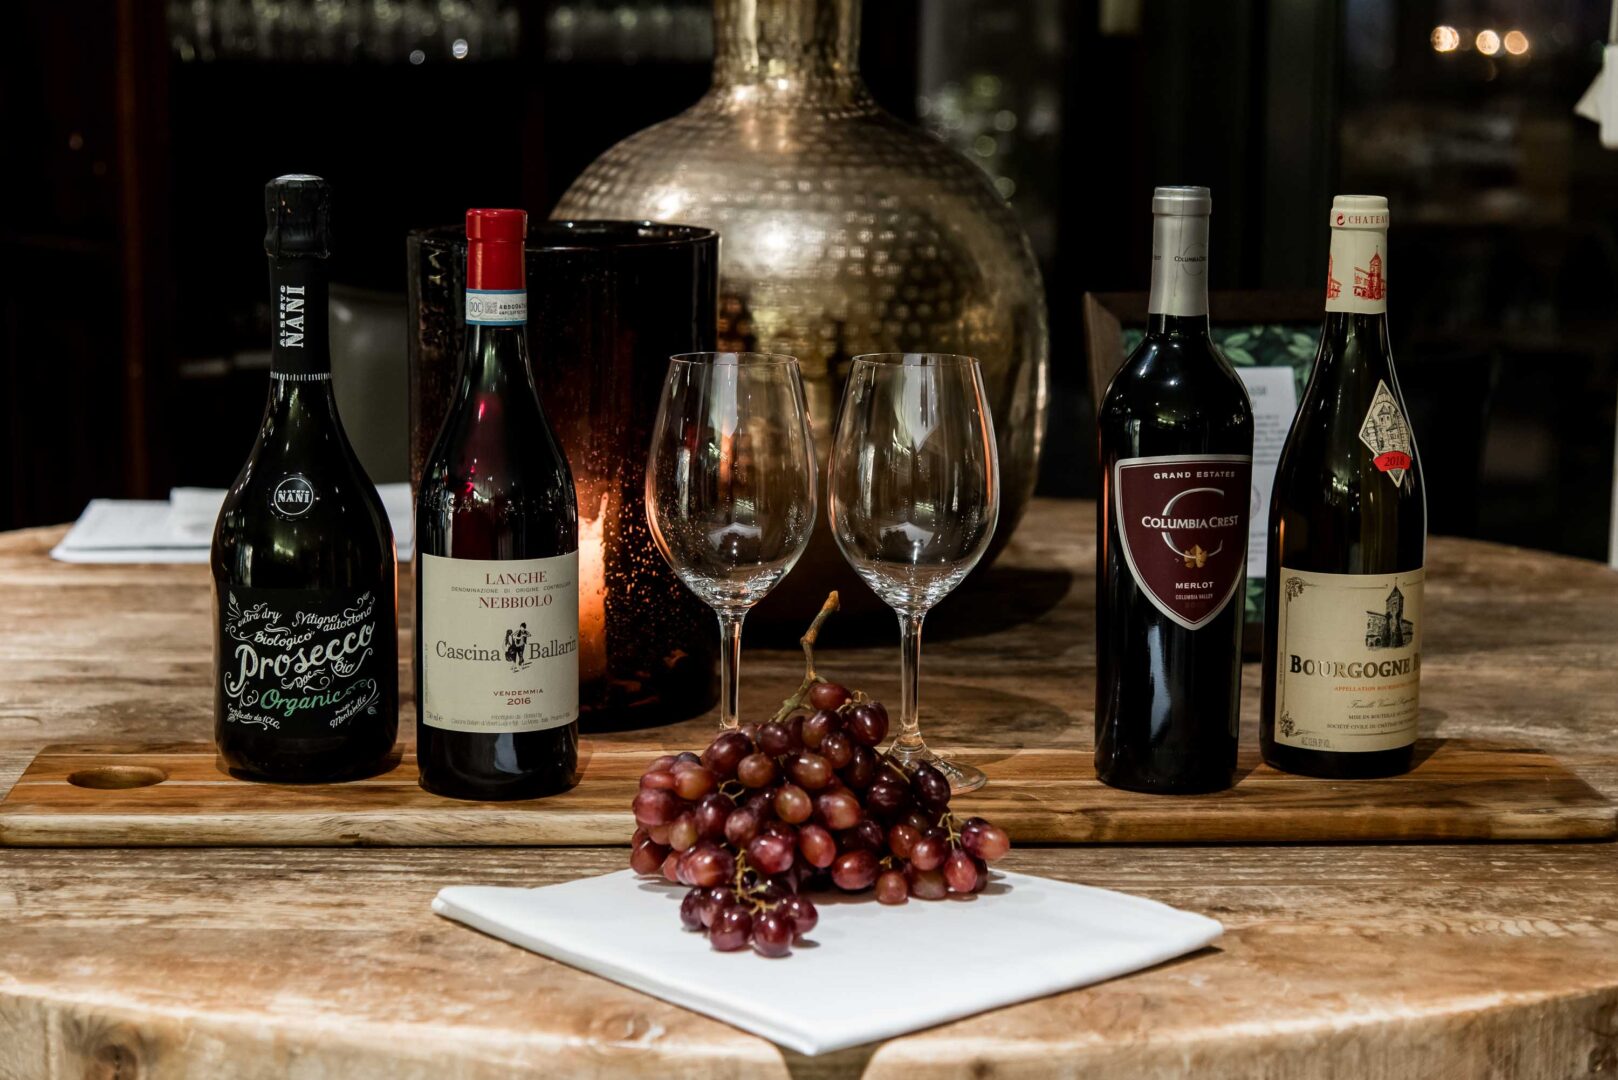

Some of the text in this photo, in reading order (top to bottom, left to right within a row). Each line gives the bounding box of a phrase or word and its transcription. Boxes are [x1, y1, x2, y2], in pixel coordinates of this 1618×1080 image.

[286, 285, 305, 348] NANI
[1384, 457, 1405, 467] 2018
[277, 493, 310, 503] NANI
[486, 571, 547, 585] LANGHE
[1175, 581, 1215, 589] MERLOT
[451, 586, 498, 594] DENOMINAZIONE
[479, 594, 553, 608] NEBBIOLO
[261, 607, 282, 624] dry
[254, 630, 312, 651] Biologico
[436, 636, 577, 661] Cascina Ballarin
[230, 622, 375, 693] Prosecco
[1290, 654, 1410, 679] BOURGOGNE
[260, 689, 342, 717] Organic
[507, 697, 532, 706] 2016
